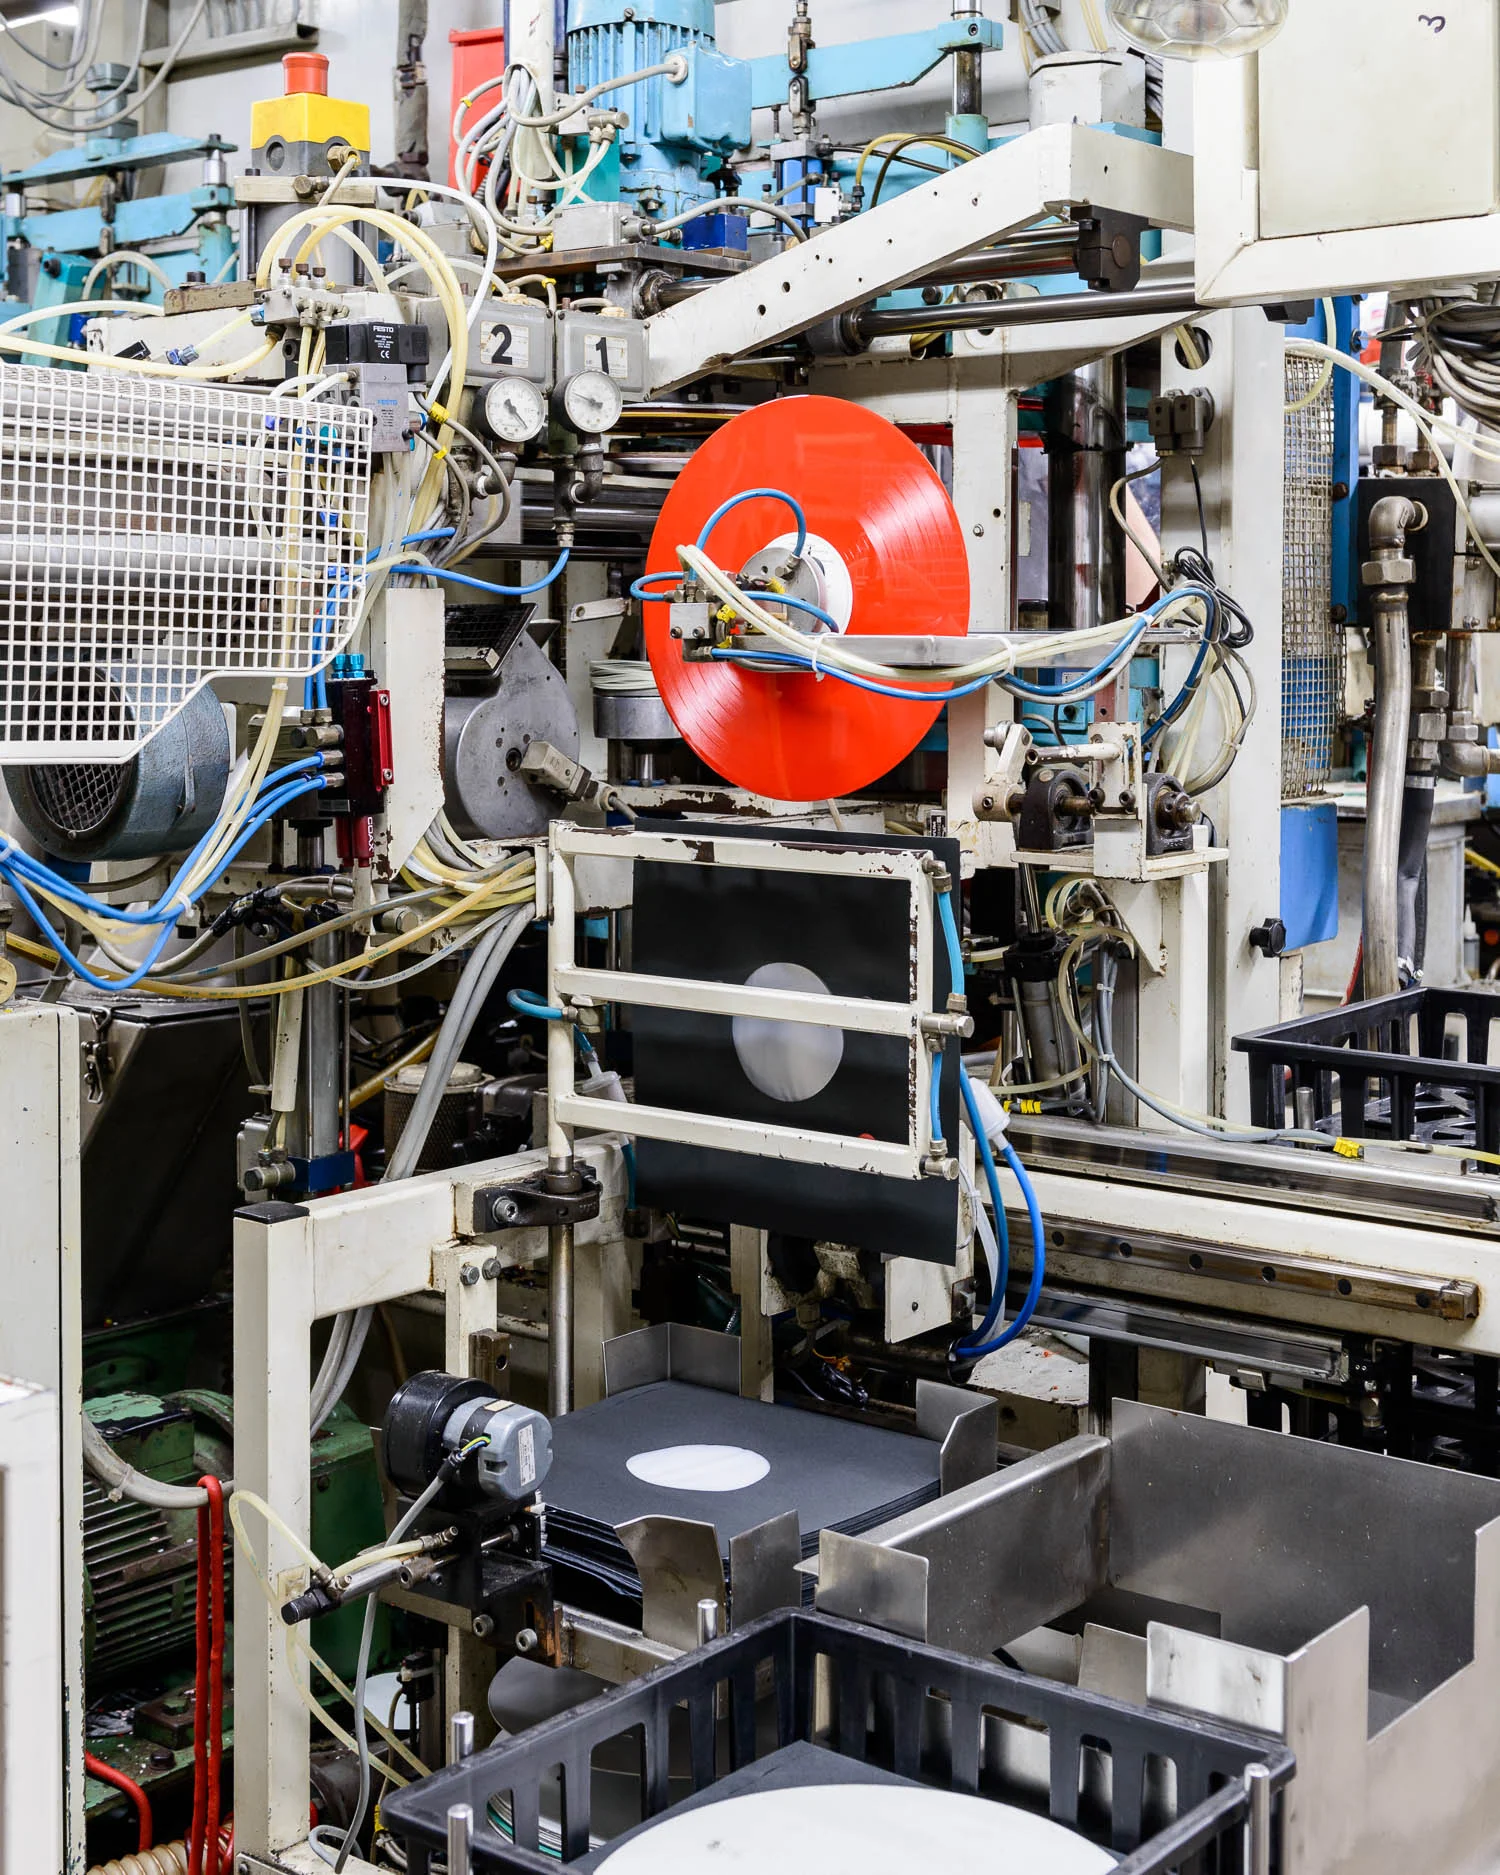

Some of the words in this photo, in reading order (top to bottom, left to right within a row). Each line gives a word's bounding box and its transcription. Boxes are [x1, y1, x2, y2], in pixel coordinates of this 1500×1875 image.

[373, 325, 394, 333] FESTO
[490, 324, 513, 366] 2
[595, 336, 610, 375] 1
[367, 816, 375, 852] COAX
